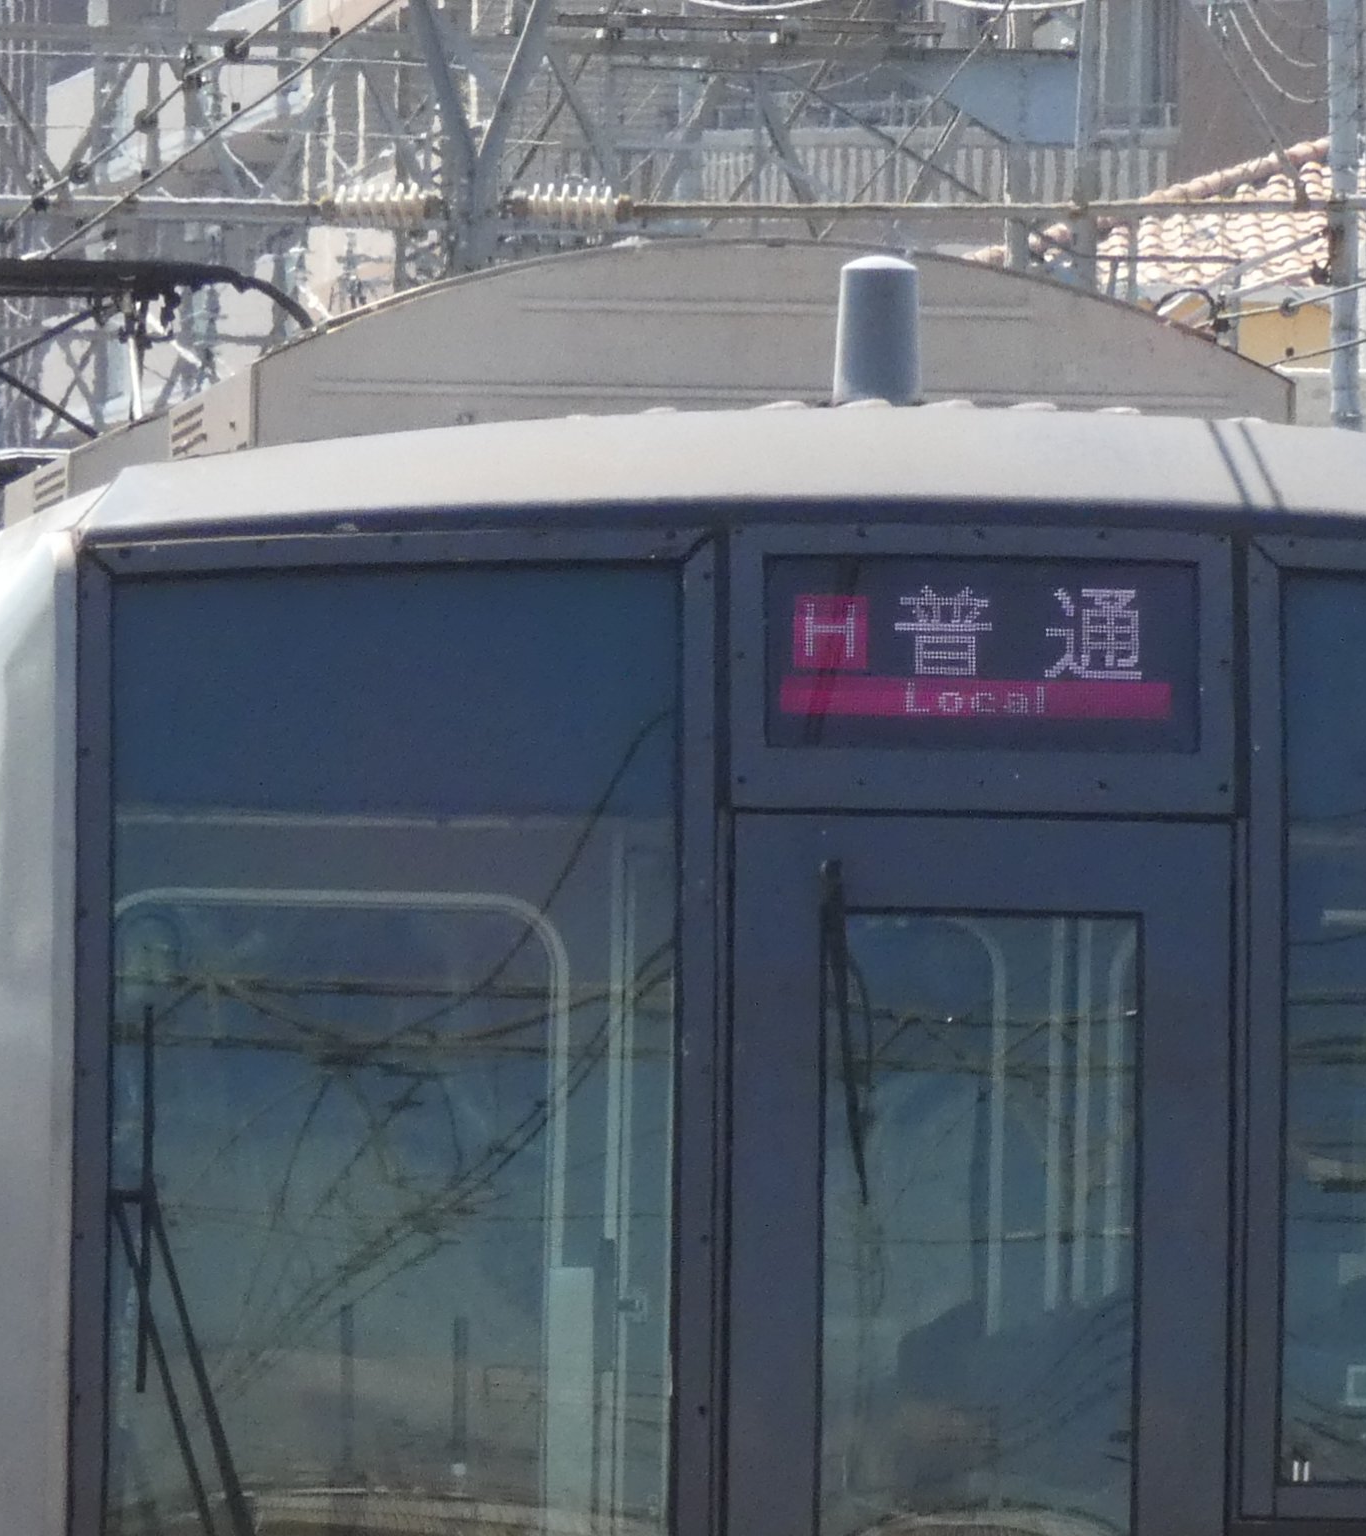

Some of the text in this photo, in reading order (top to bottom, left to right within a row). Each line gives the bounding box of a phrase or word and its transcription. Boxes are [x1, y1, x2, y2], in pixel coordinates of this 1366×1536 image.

[803, 585, 1142, 680] H 普通
[905, 682, 1045, 714] Local
